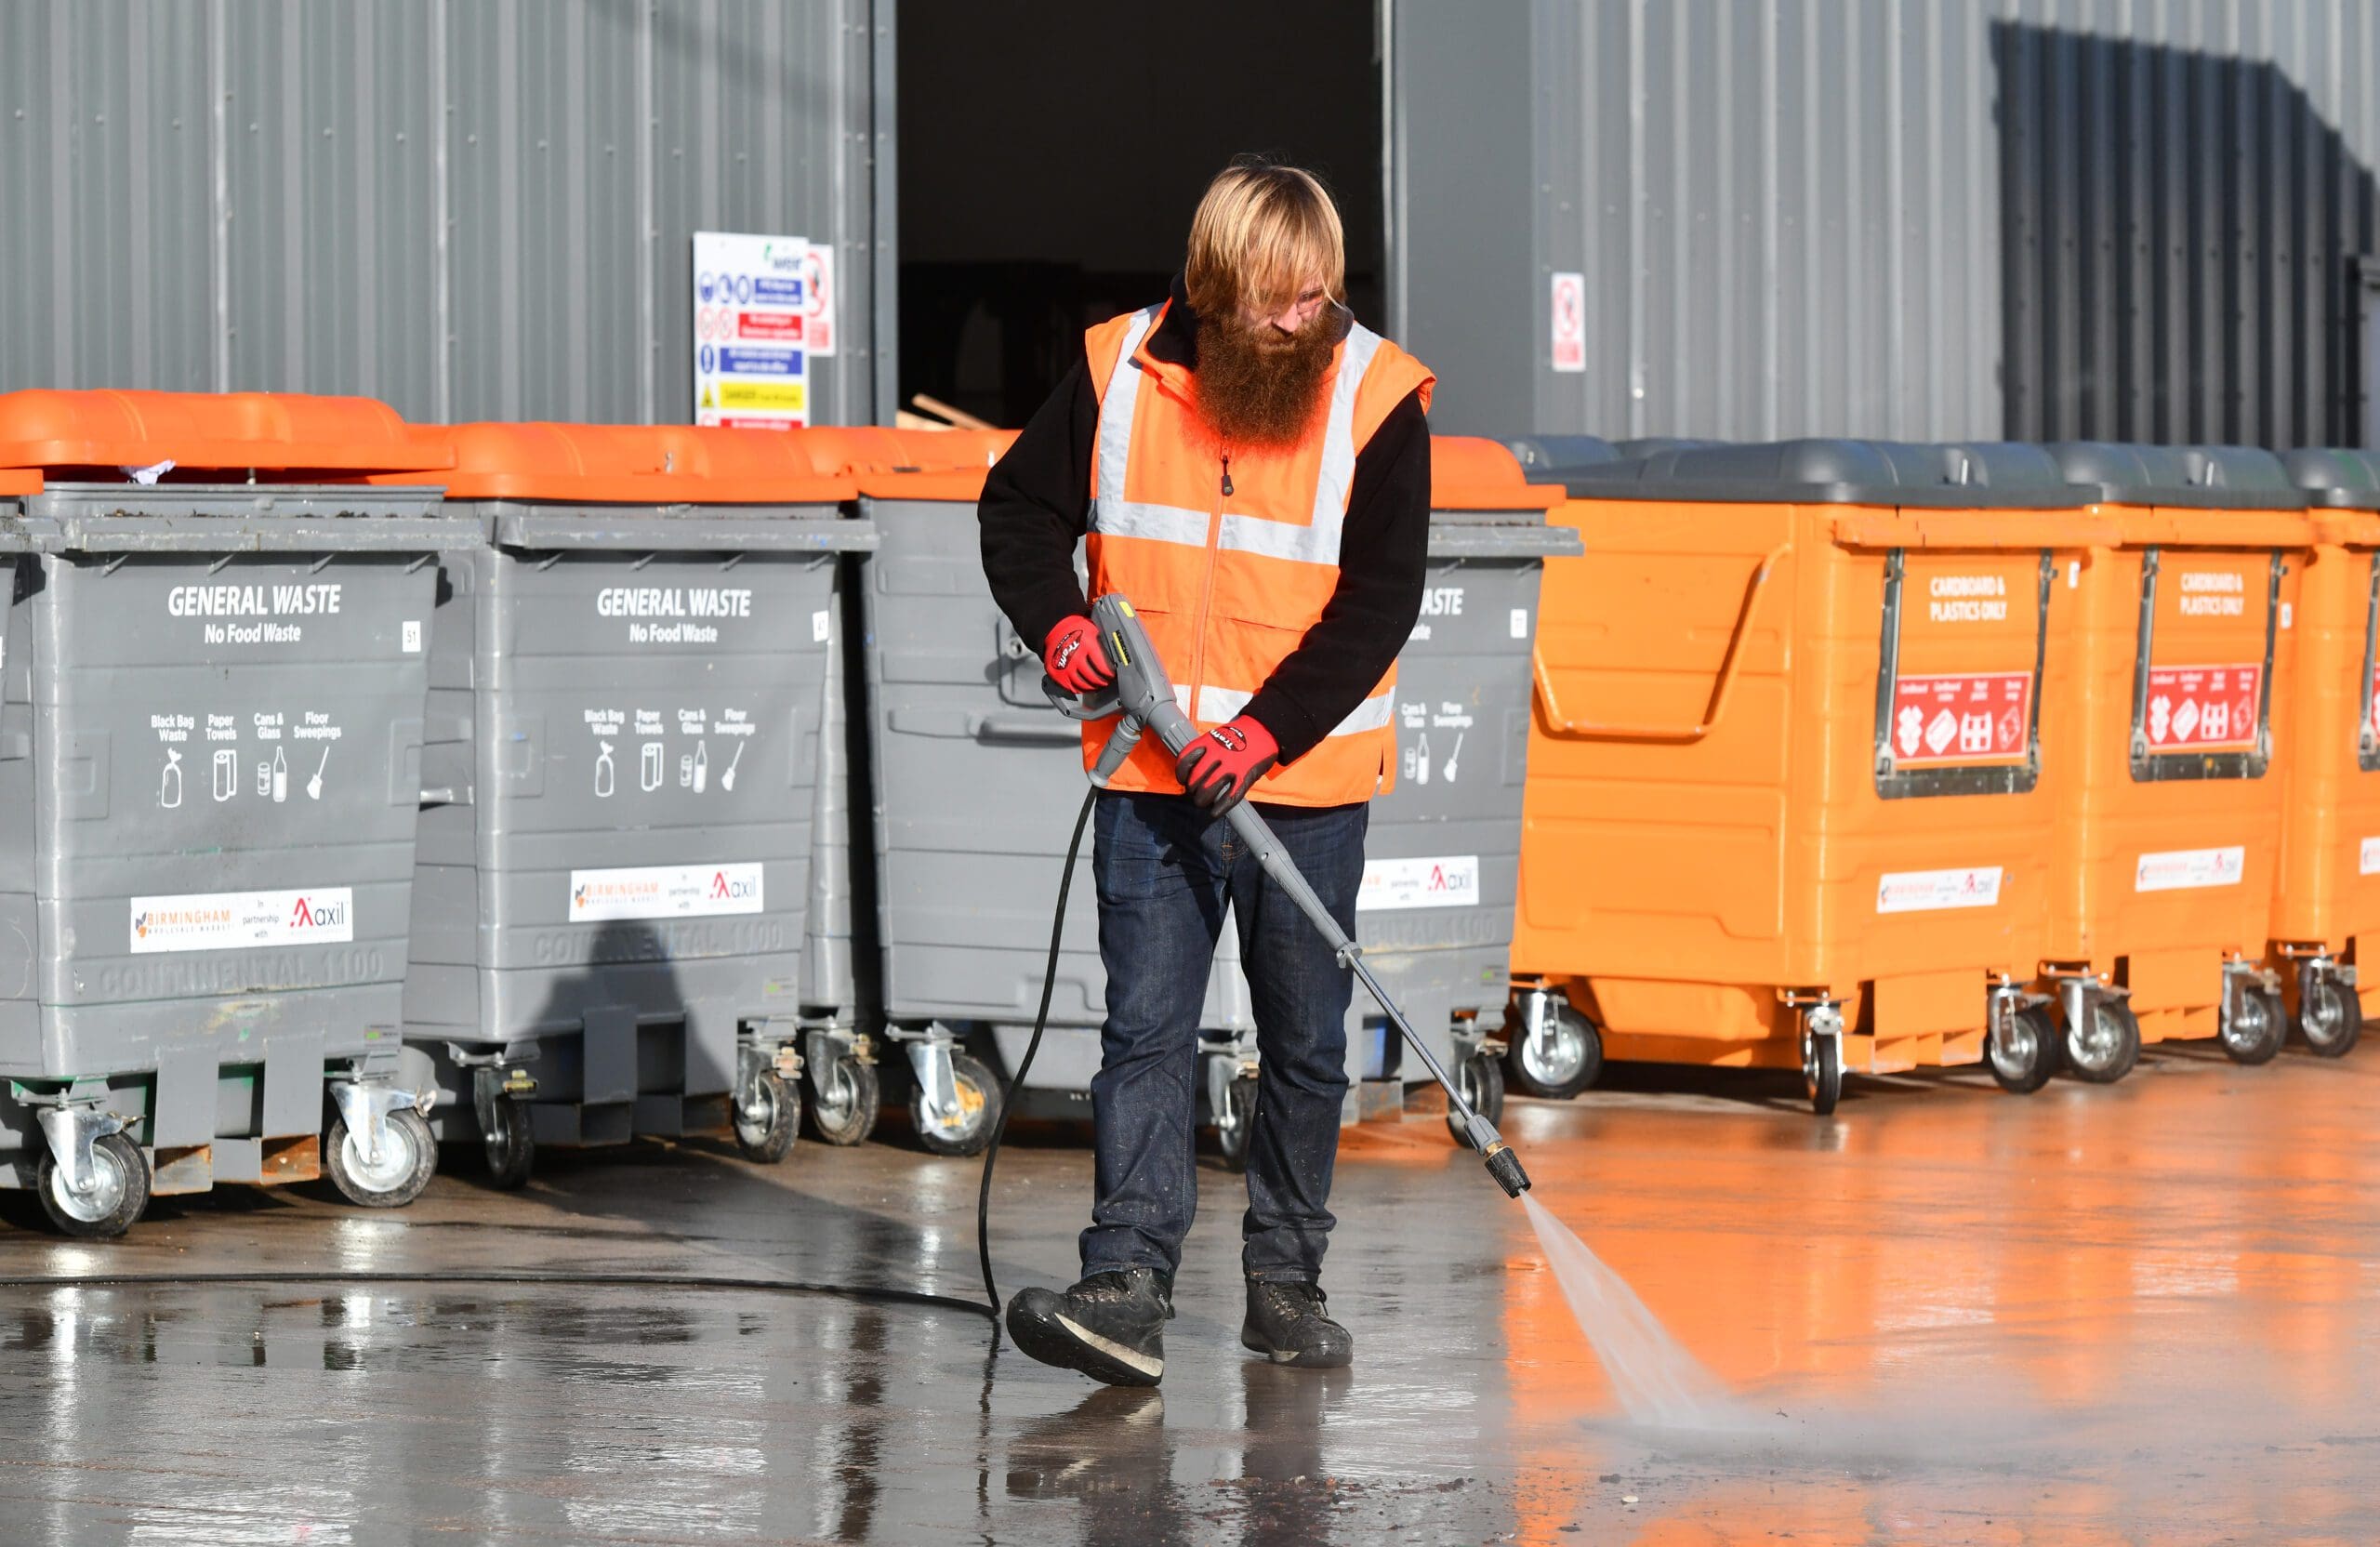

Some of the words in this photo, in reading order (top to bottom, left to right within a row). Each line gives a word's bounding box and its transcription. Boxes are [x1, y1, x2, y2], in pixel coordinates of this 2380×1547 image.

[168, 586, 268, 616] GENERAL
[272, 584, 342, 615] WASTE
[597, 588, 686, 616] GENERAL
[689, 588, 752, 616] WASTE
[205, 624, 225, 643] No
[227, 623, 262, 643] Food
[264, 623, 301, 642] Waste
[406, 629, 416, 644] 51
[629, 624, 648, 642] No
[650, 624, 681, 642] Food
[682, 624, 718, 642] Waste
[151, 714, 176, 728] Black
[177, 714, 194, 730] Bag
[207, 713, 234, 729] Paper
[254, 712, 275, 726] Cans
[276, 712, 284, 725] &
[305, 711, 329, 725] Floor
[159, 728, 188, 742] Waste
[205, 727, 238, 741] Towels
[258, 726, 281, 739] Glass
[294, 725, 342, 740] Sweepings
[147, 908, 231, 927] BIRMINGHAM
[243, 914, 280, 927] partnership
[314, 900, 344, 927] axil
